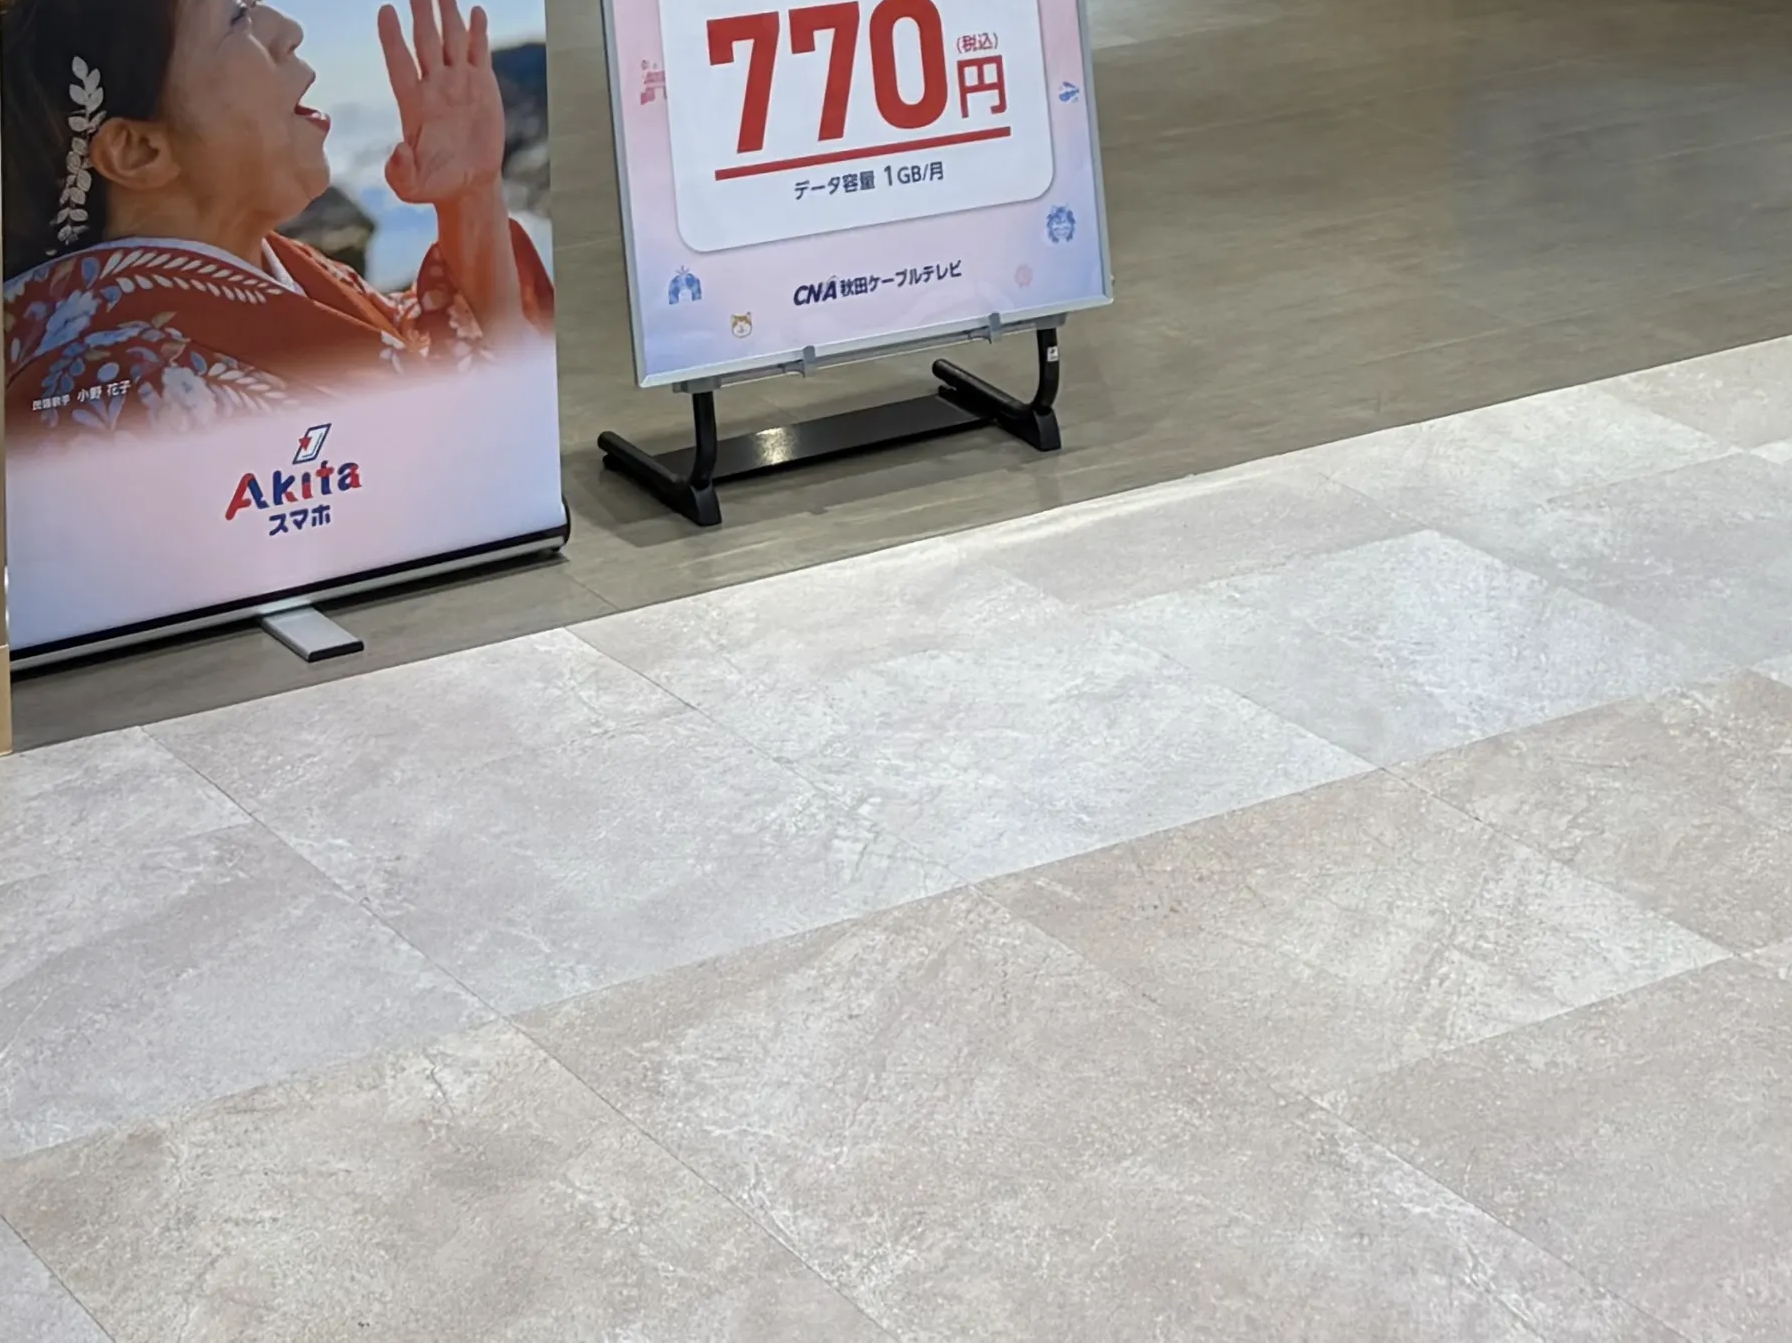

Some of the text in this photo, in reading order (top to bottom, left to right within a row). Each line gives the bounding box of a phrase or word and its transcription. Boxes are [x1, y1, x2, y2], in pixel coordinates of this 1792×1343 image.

[956, 32, 999, 55] (税込)
[793, 161, 945, 201] データ容量 1GB/月
[792, 259, 963, 306] CNA 秋田ケーブルテレビ
[77, 385, 103, 403] 小野
[107, 379, 132, 397] 花子
[224, 459, 363, 521] Akita
[268, 505, 332, 536] スマホ
